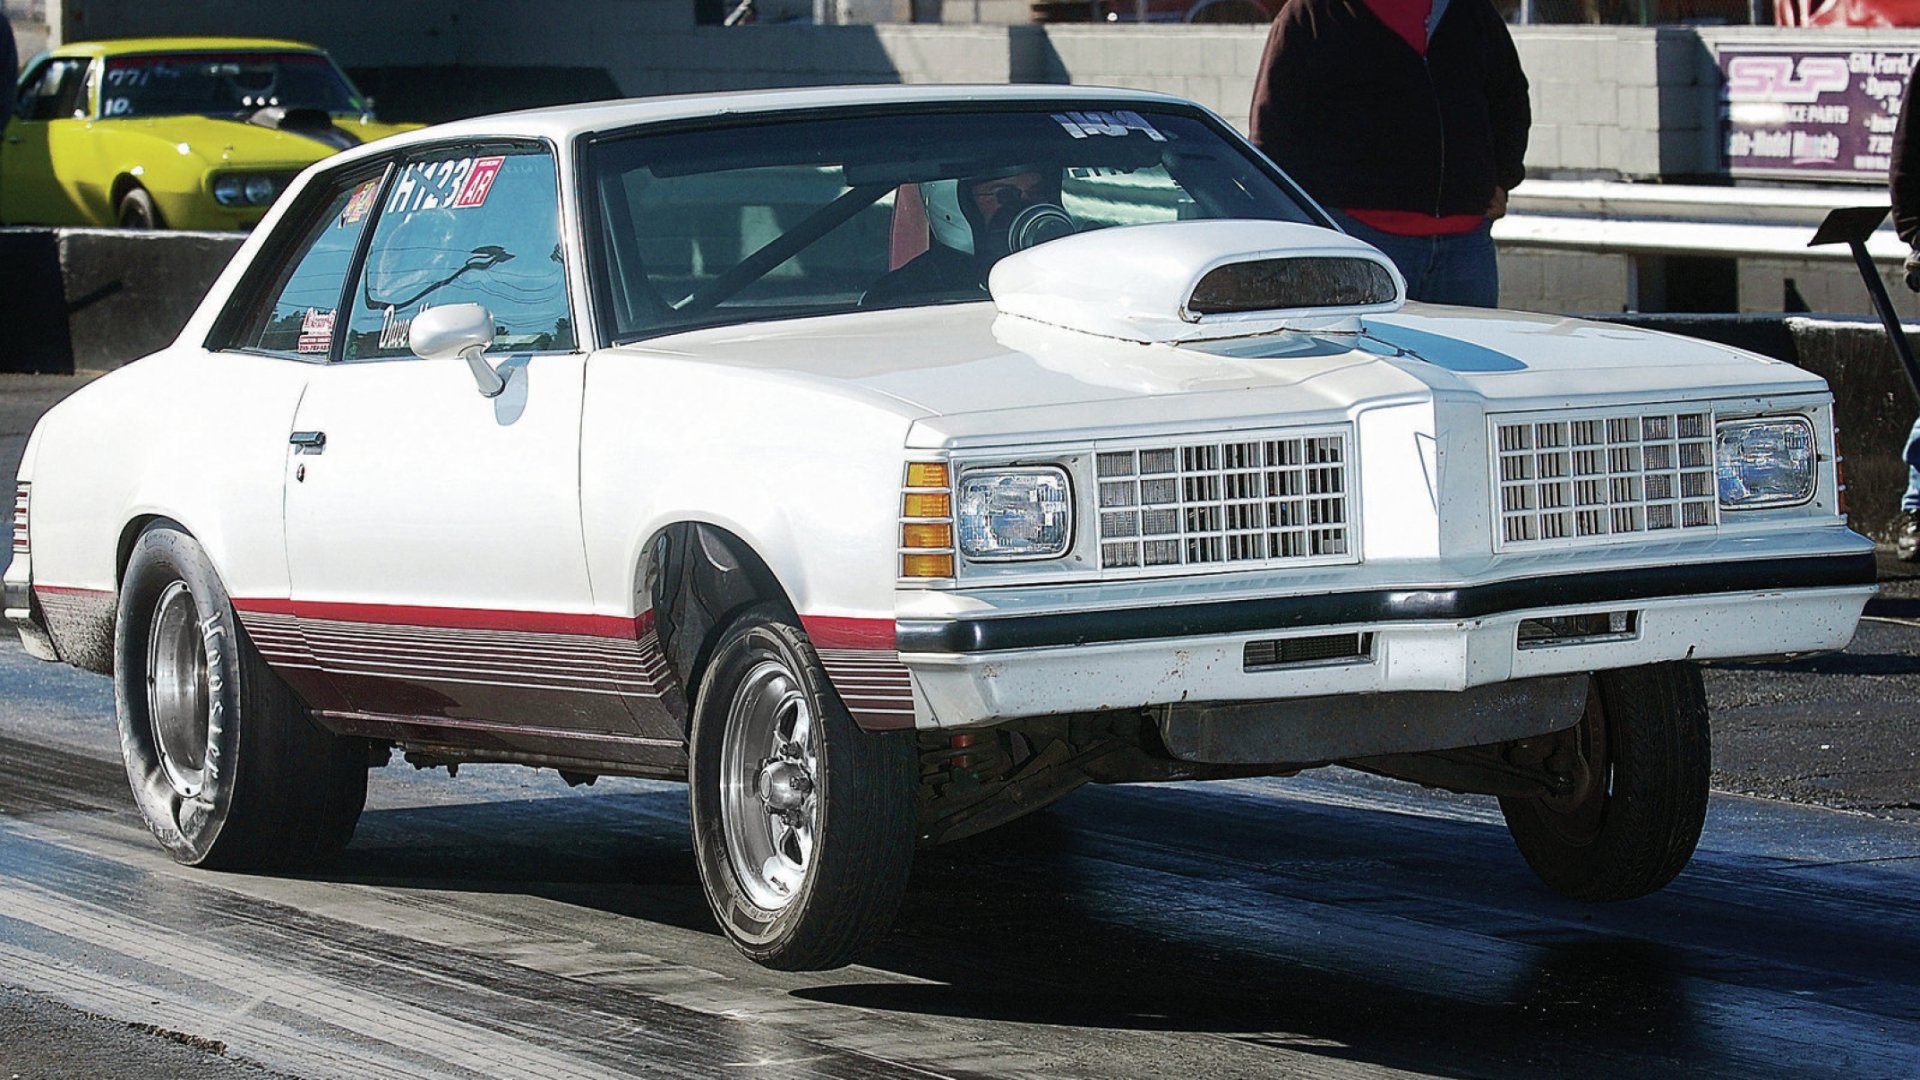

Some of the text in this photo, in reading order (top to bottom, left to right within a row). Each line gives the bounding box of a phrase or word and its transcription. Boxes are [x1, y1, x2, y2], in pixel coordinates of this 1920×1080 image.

[1726, 56, 1850, 103] SLP
[1808, 104, 1850, 124] PARTS
[461, 169, 495, 205] AR
[378, 304, 410, 349] Dave
